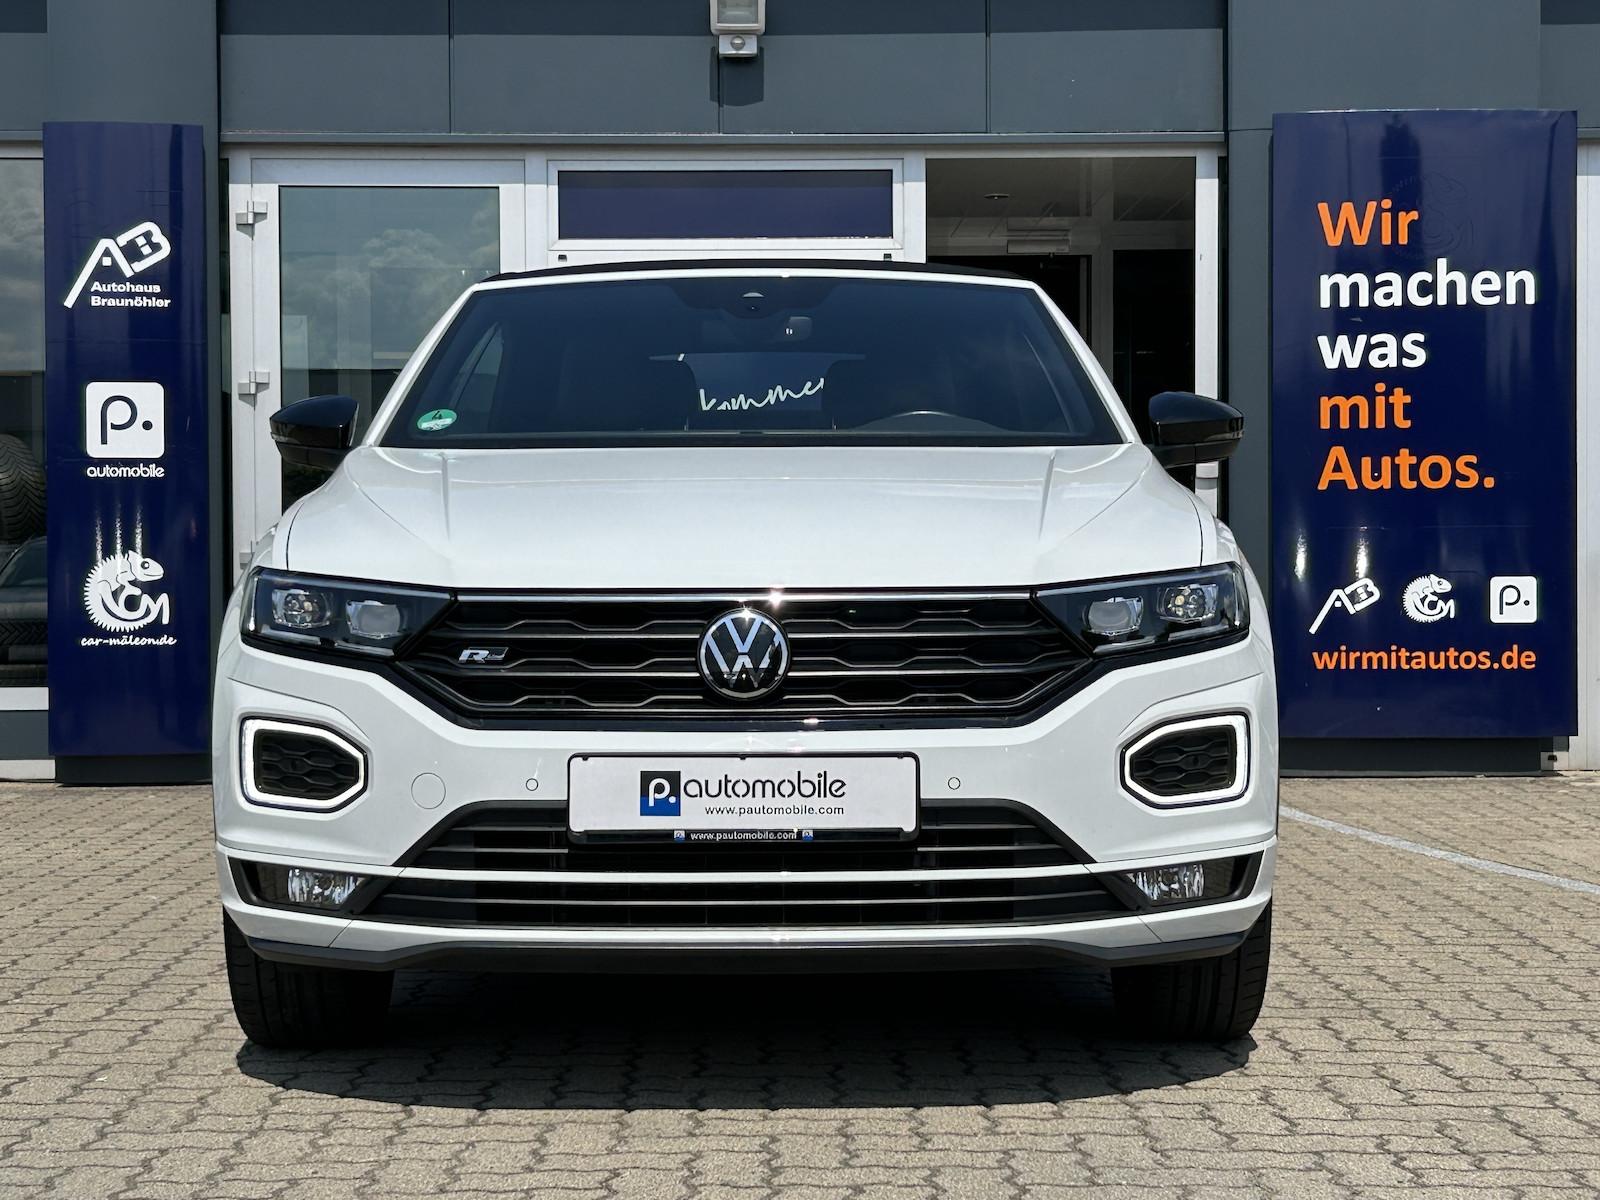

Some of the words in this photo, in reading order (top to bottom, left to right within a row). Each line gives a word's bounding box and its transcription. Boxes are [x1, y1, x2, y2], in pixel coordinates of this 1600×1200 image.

[1317, 199, 1419, 247] Wir
[90, 281, 161, 293] Autohaus
[1319, 258, 1536, 308] machen
[1317, 332, 1427, 369] was
[1319, 382, 1412, 429] mit
[86, 464, 165, 478] automobile
[1317, 446, 1495, 490] Autos.
[1311, 644, 1537, 670] wirmitautos.de
[683, 771, 847, 798] automobile
[704, 804, 845, 816] www.pautomobile.com
[690, 830, 797, 841] www.pautomobile.com
